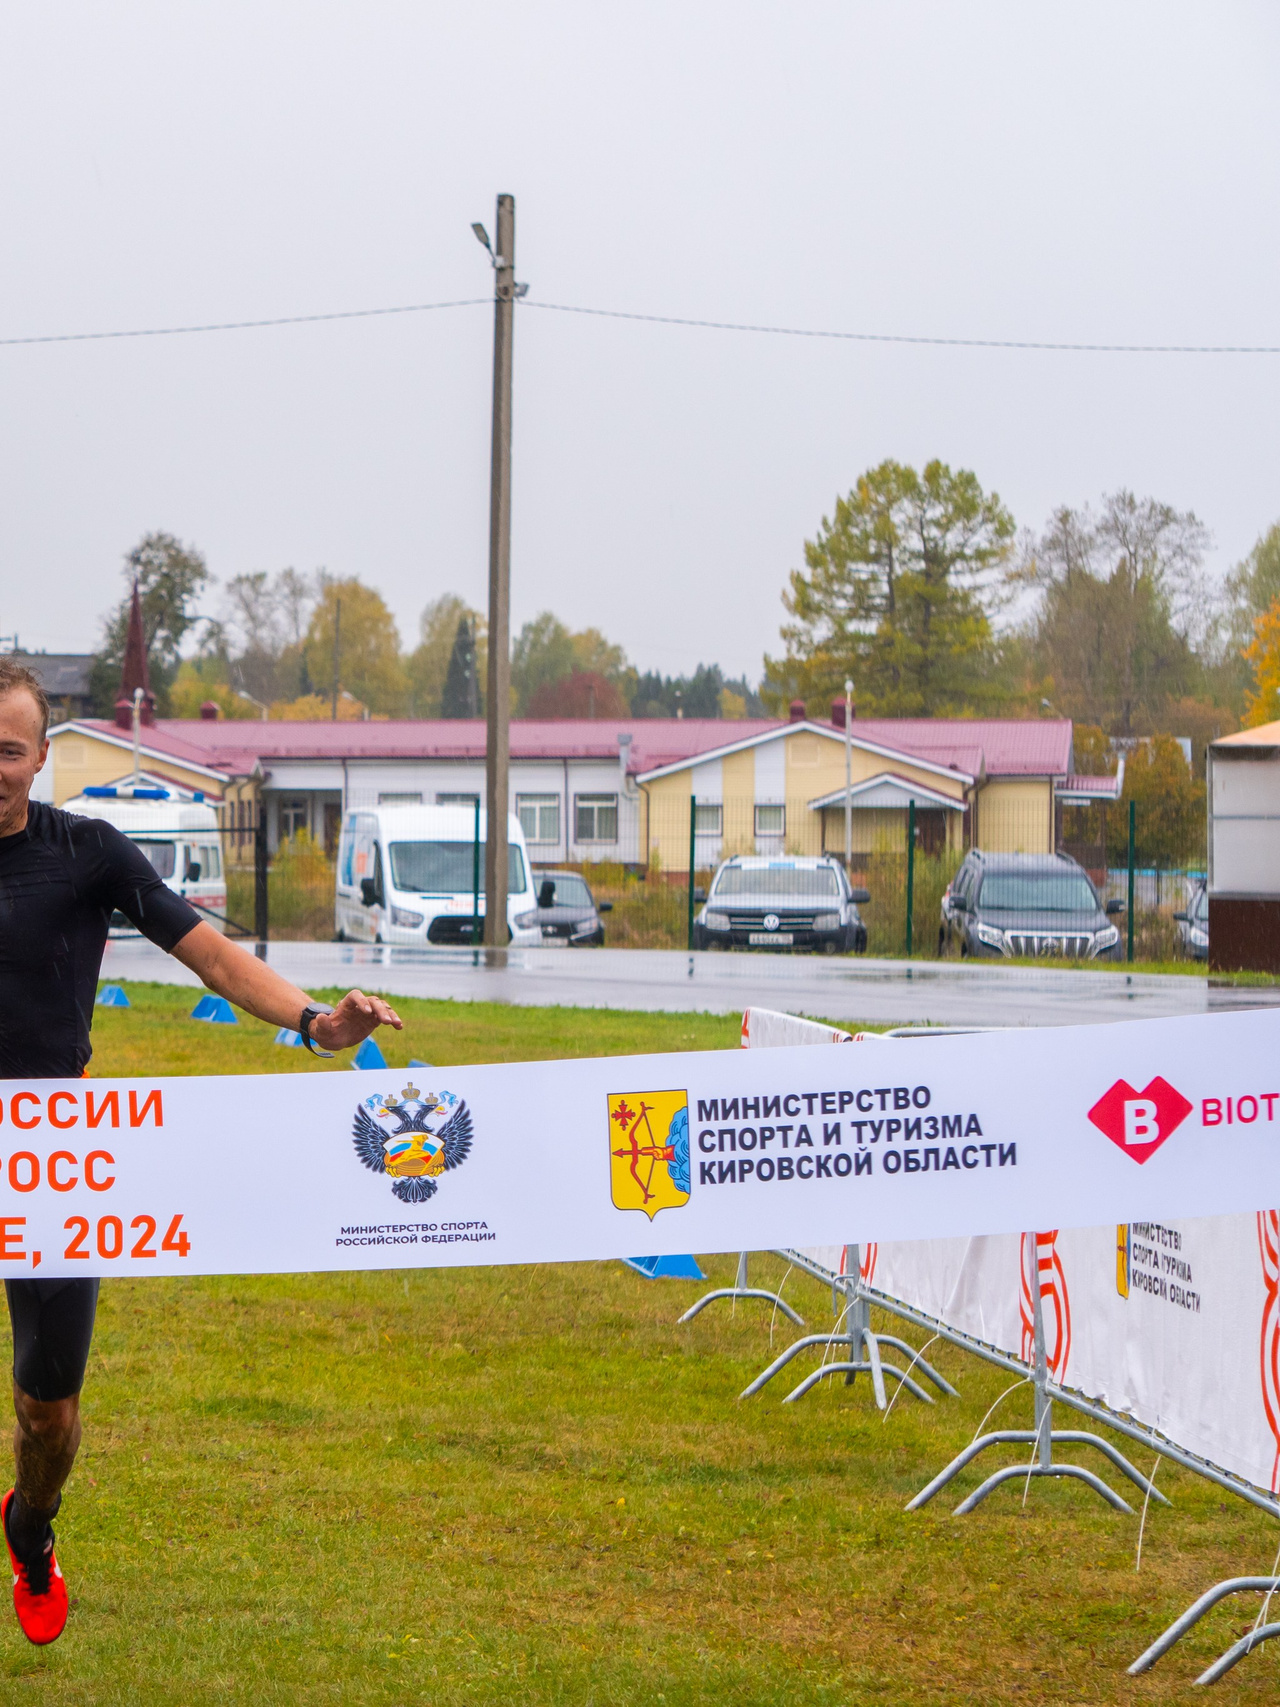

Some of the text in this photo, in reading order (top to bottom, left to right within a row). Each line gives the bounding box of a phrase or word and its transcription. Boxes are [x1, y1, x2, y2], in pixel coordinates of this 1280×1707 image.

[697, 1085, 931, 1122] МИНИСТЕРСТВО
[698, 1113, 983, 1153] СПОРТА И ТУРИЗМА
[699, 1142, 1017, 1185] КИРОВСКОЙ ОБЛАСТИ
[63, 1214, 191, 1260] 2024
[335, 1232, 496, 1247] РОССИЙСКОЙ ФЕДЕРАЦИИ
[340, 1221, 489, 1235] МИНИСТЕРСТВО СПОРТА
